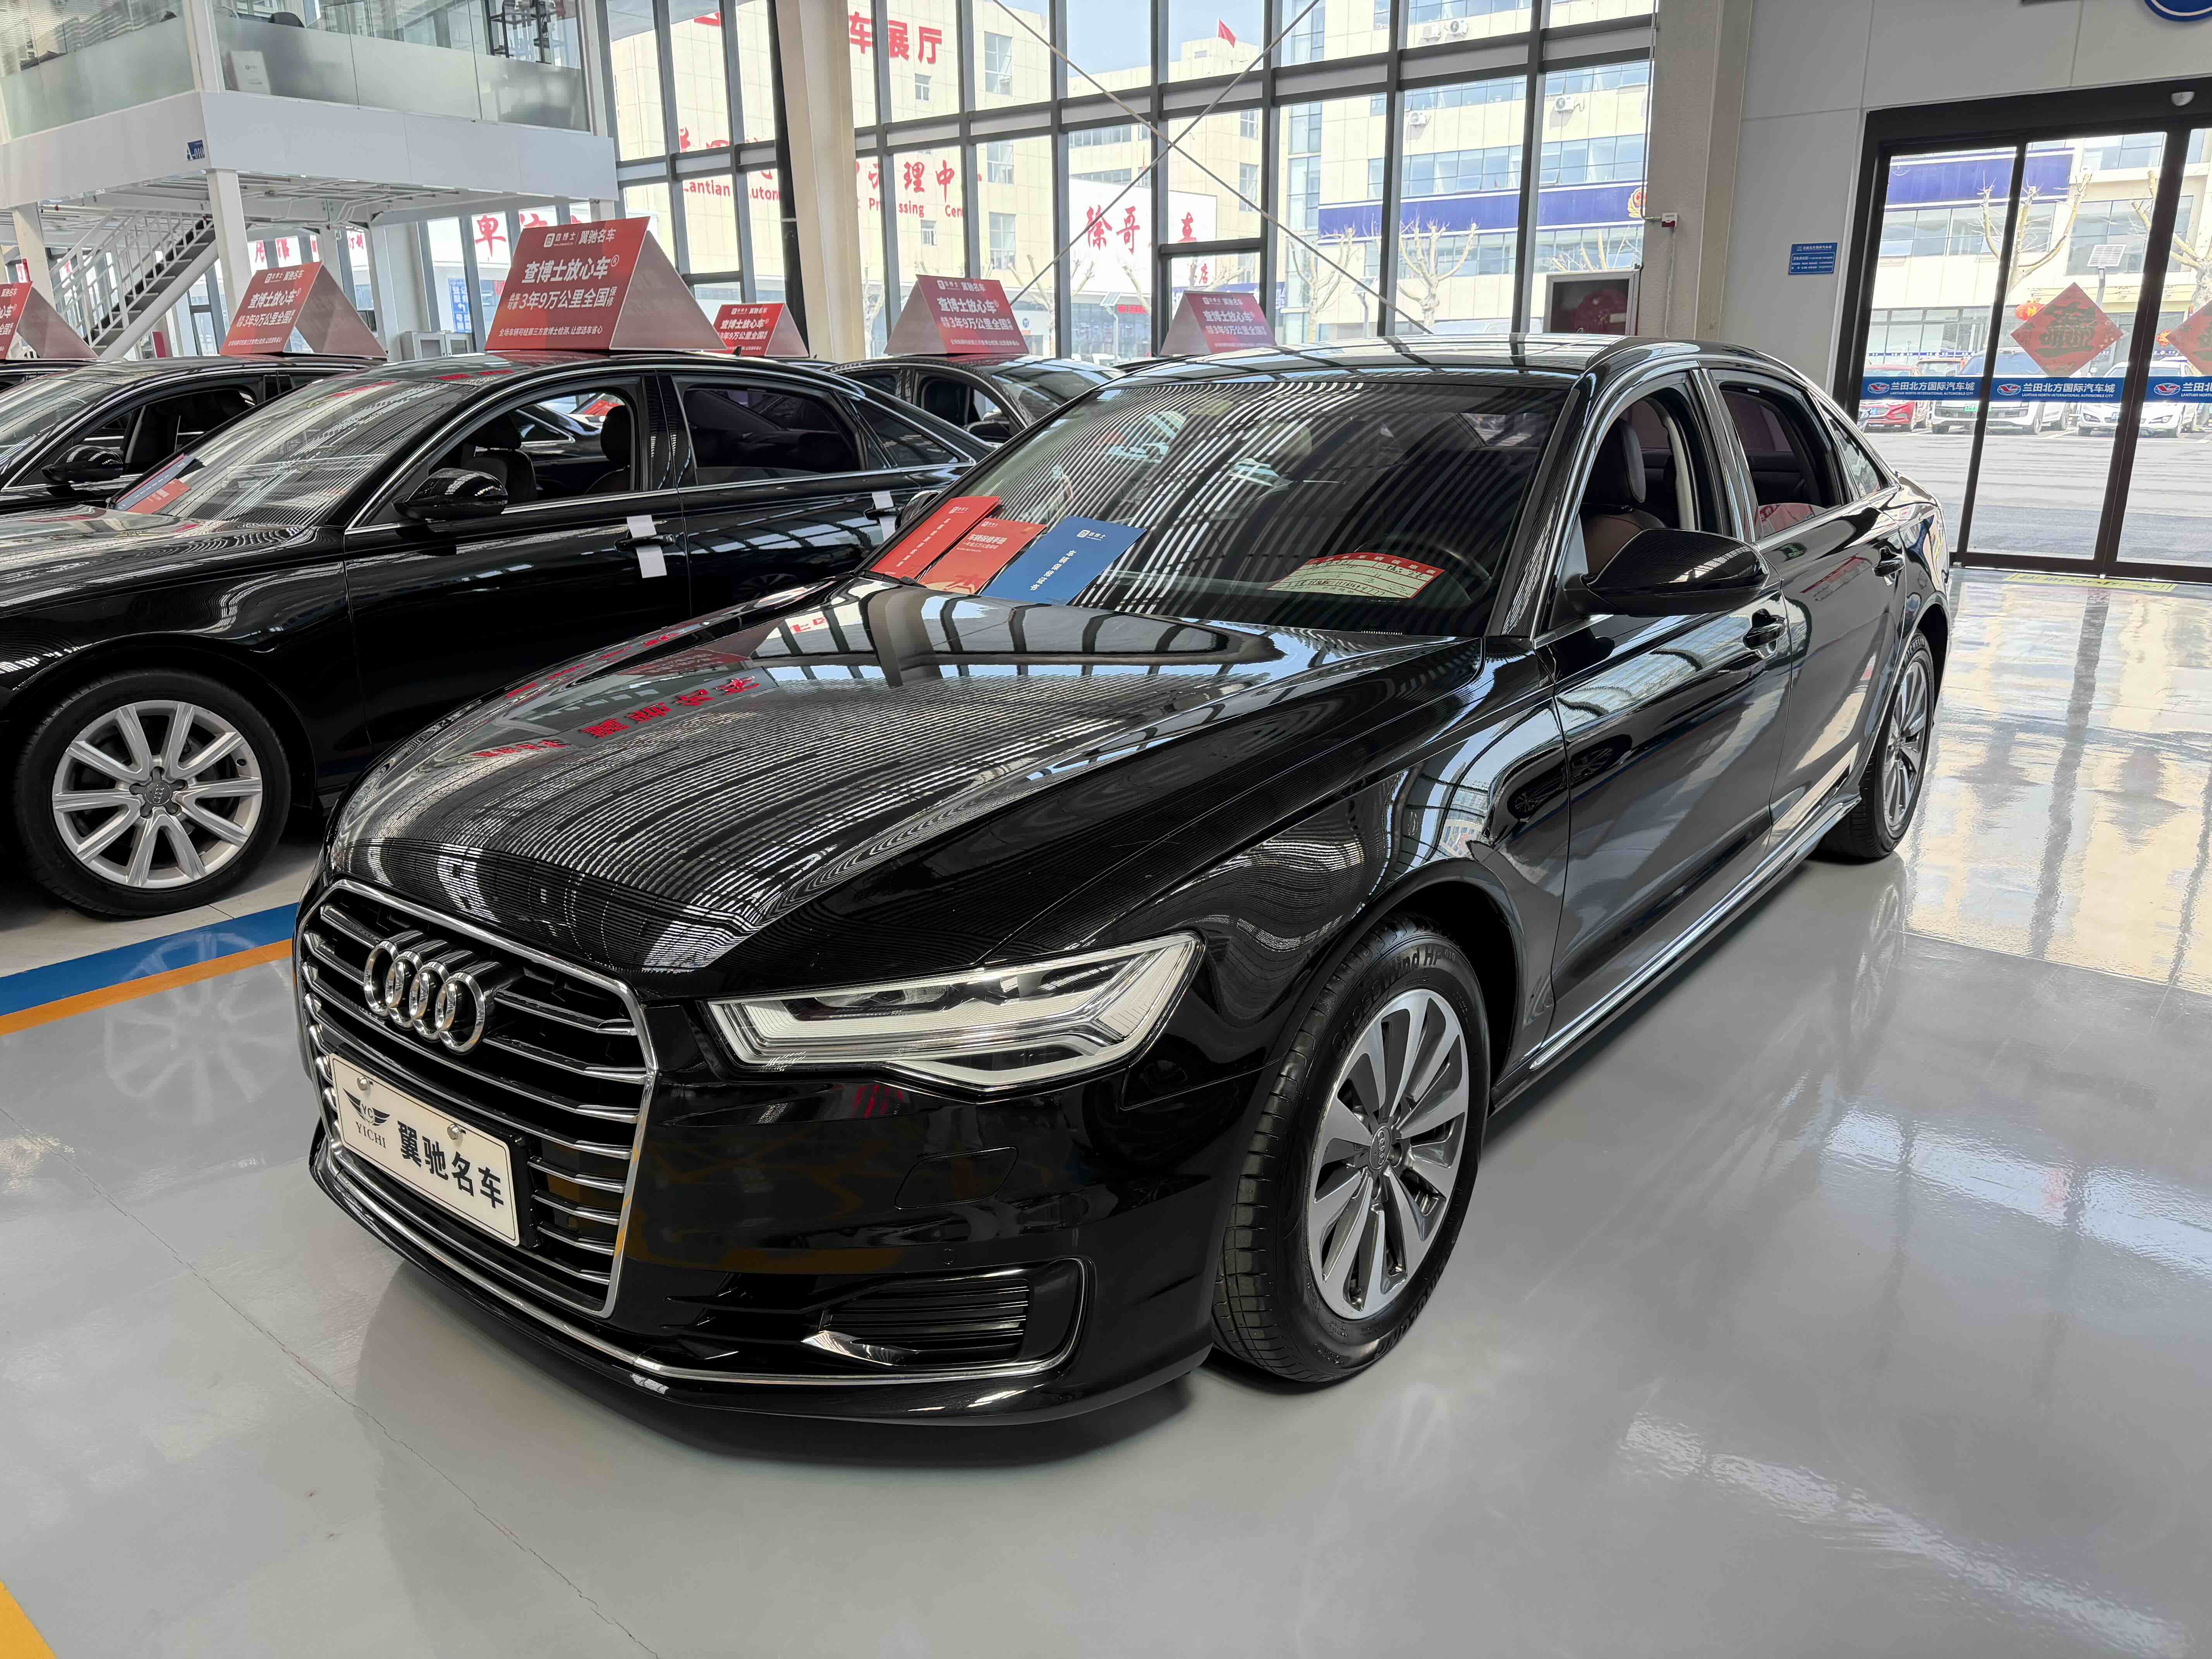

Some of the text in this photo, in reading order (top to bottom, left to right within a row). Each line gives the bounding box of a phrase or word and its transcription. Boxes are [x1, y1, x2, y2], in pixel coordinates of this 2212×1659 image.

[683, 179, 730, 197] antian
[1890, 381, 1975, 391] 兰田北方国际汽车城
[2022, 383, 2116, 393] 兰田北方国际汽车城
[355, 1121, 386, 1149] YICHI
[397, 1120, 505, 1209] 翼驰名车
